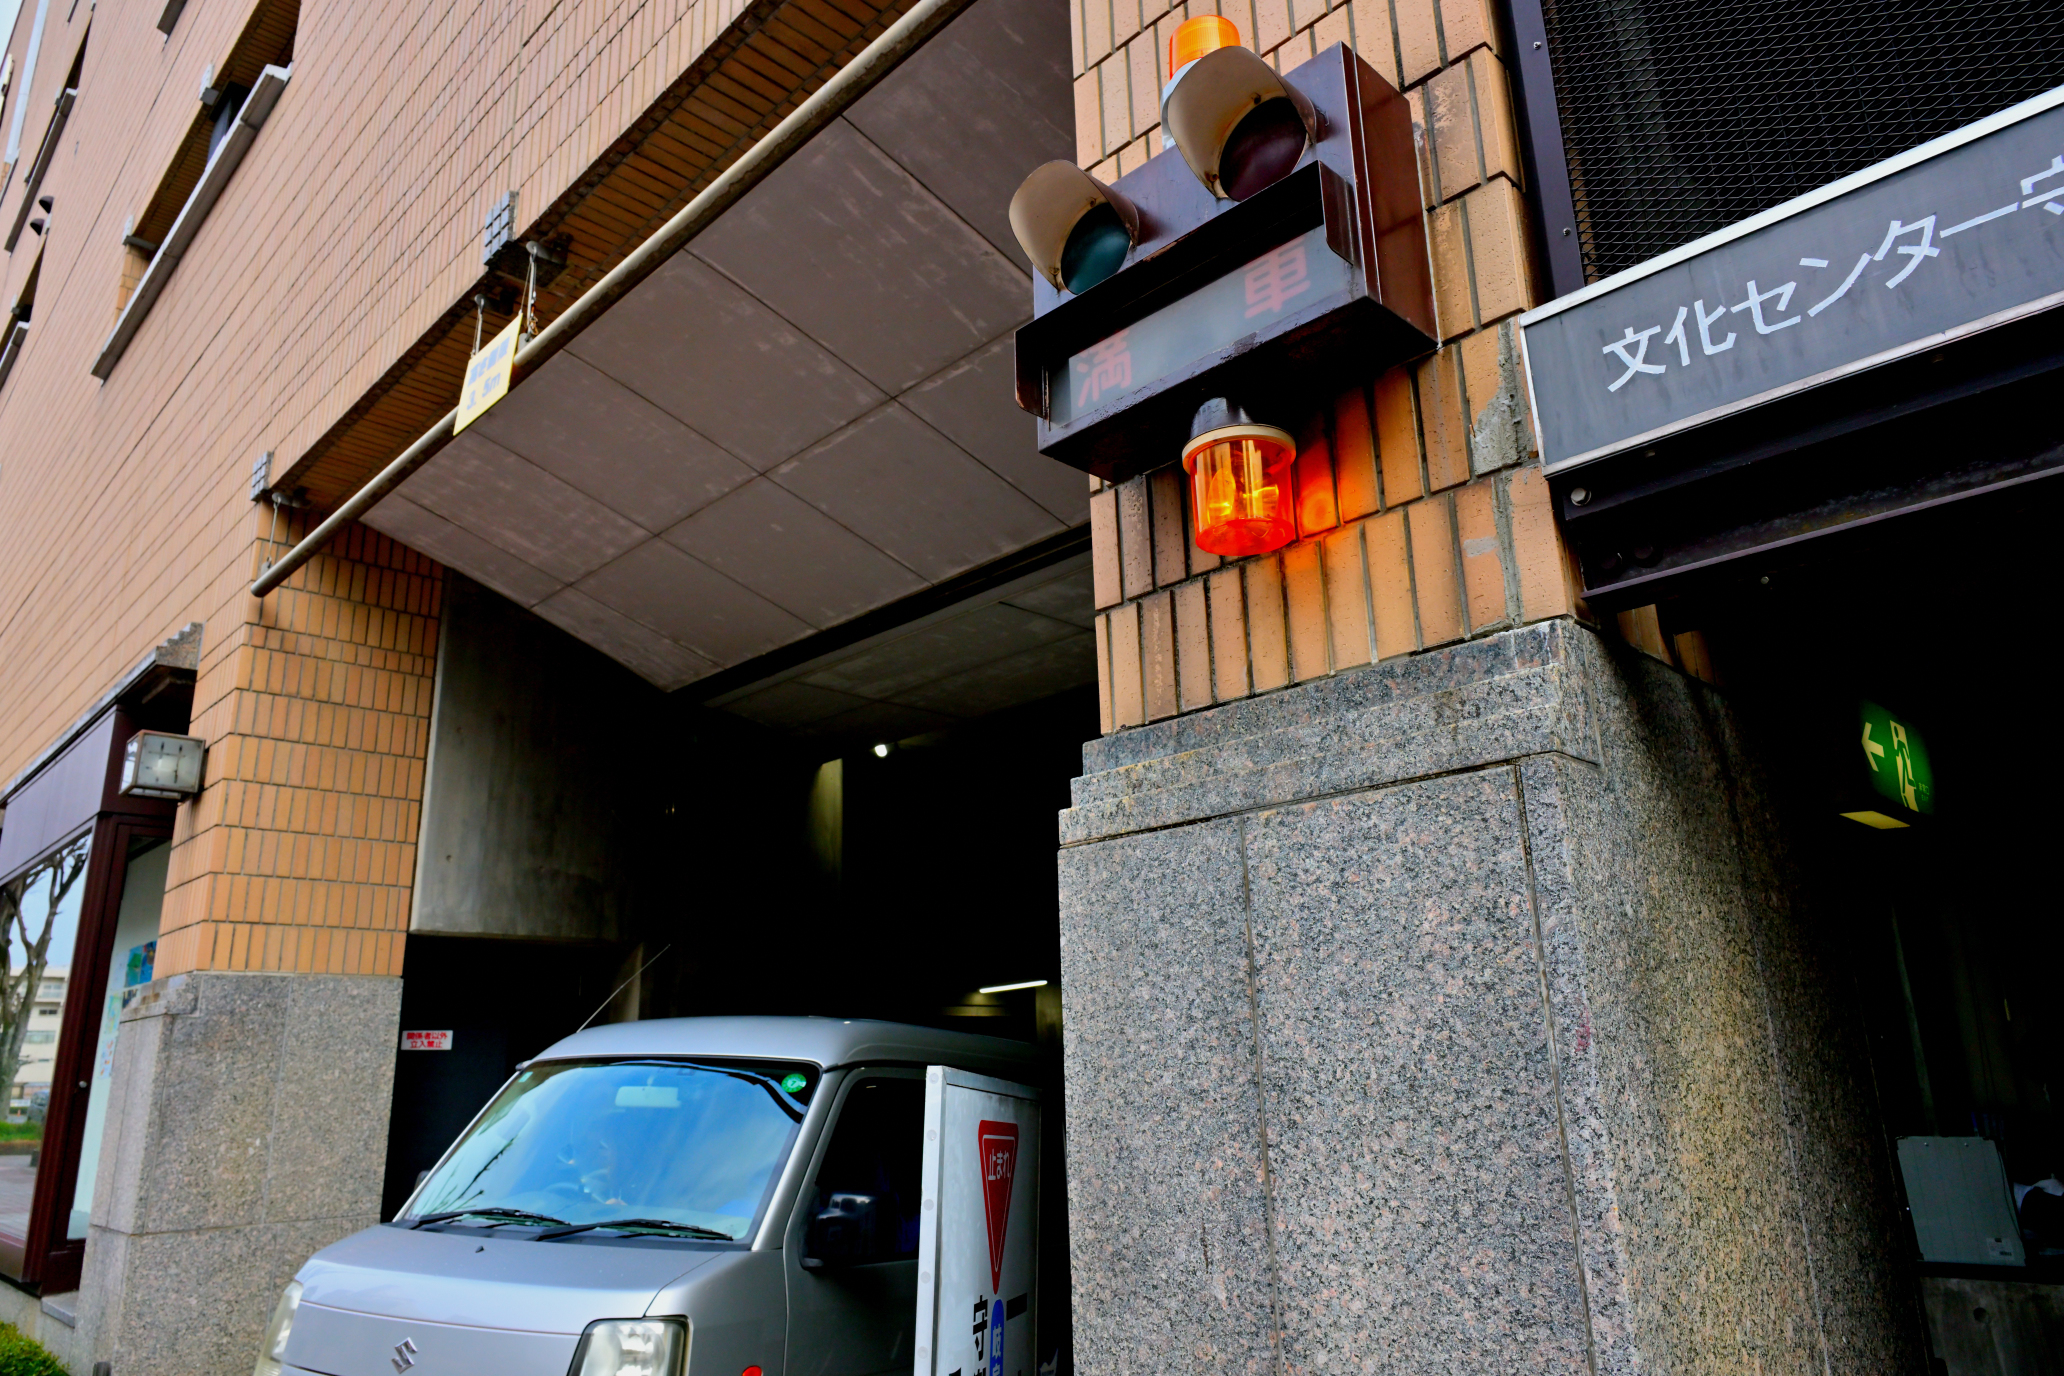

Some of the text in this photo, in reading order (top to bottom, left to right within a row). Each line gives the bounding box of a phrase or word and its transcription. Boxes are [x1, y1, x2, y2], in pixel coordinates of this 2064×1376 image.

[406, 1031, 447, 1040] 関係者以外
[410, 1040, 442, 1049] 立入禁止
[988, 1148, 1010, 1181] 止まれ
[973, 1295, 988, 1376] 守
